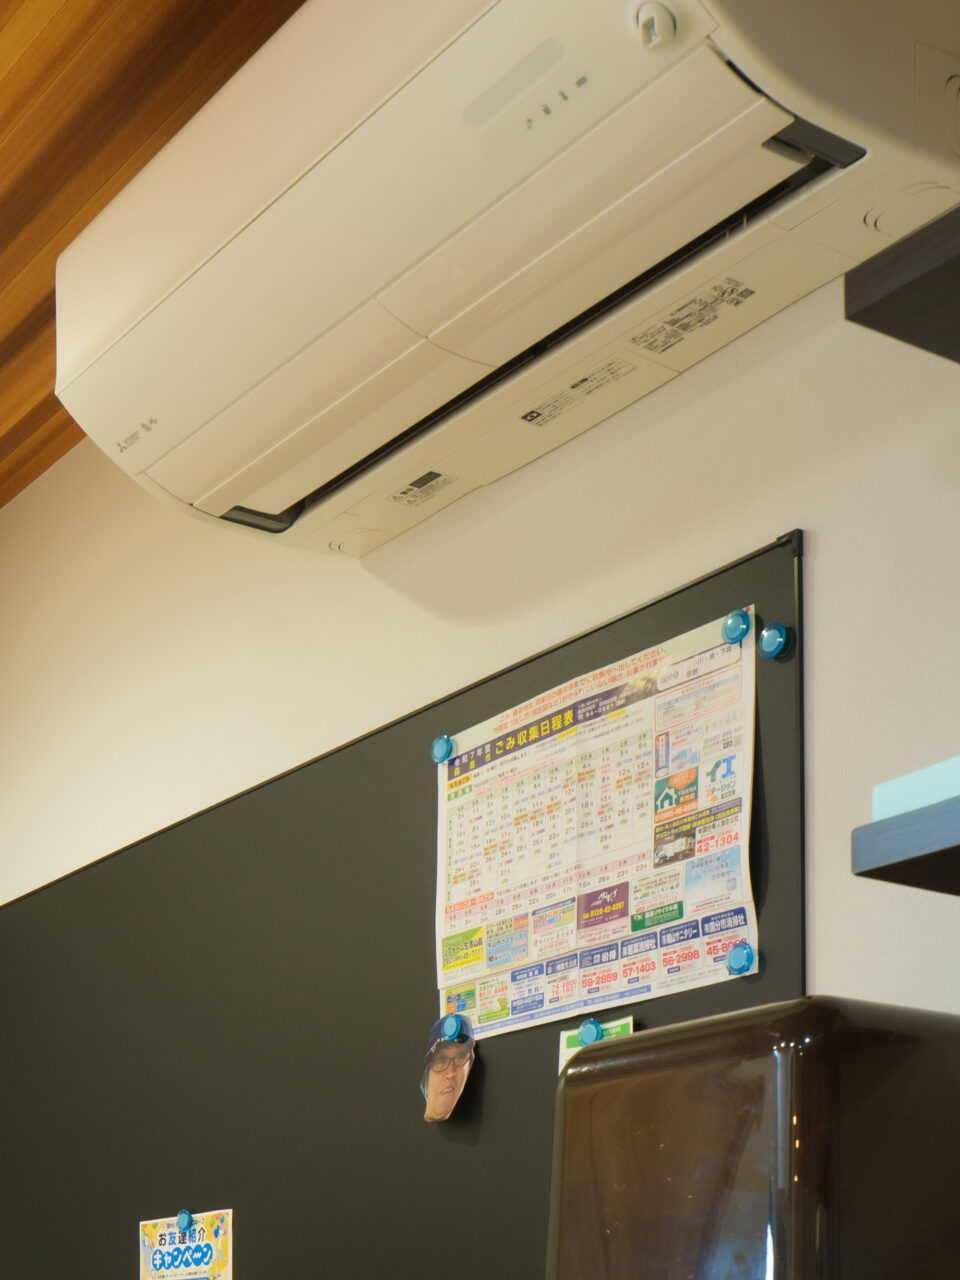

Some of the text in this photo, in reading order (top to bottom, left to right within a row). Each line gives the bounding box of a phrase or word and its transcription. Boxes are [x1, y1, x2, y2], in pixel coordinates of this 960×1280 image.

[495, 709, 574, 754] ごみ収集日程表
[695, 831, 739, 855] 42-1304
[622, 960, 656, 978] 57-1403
[662, 948, 700, 968] 56-2998
[581, 970, 617, 989] 59-2859
[158, 1225, 206, 1247] お友達紹介
[152, 1242, 213, 1271] キャンペーン
